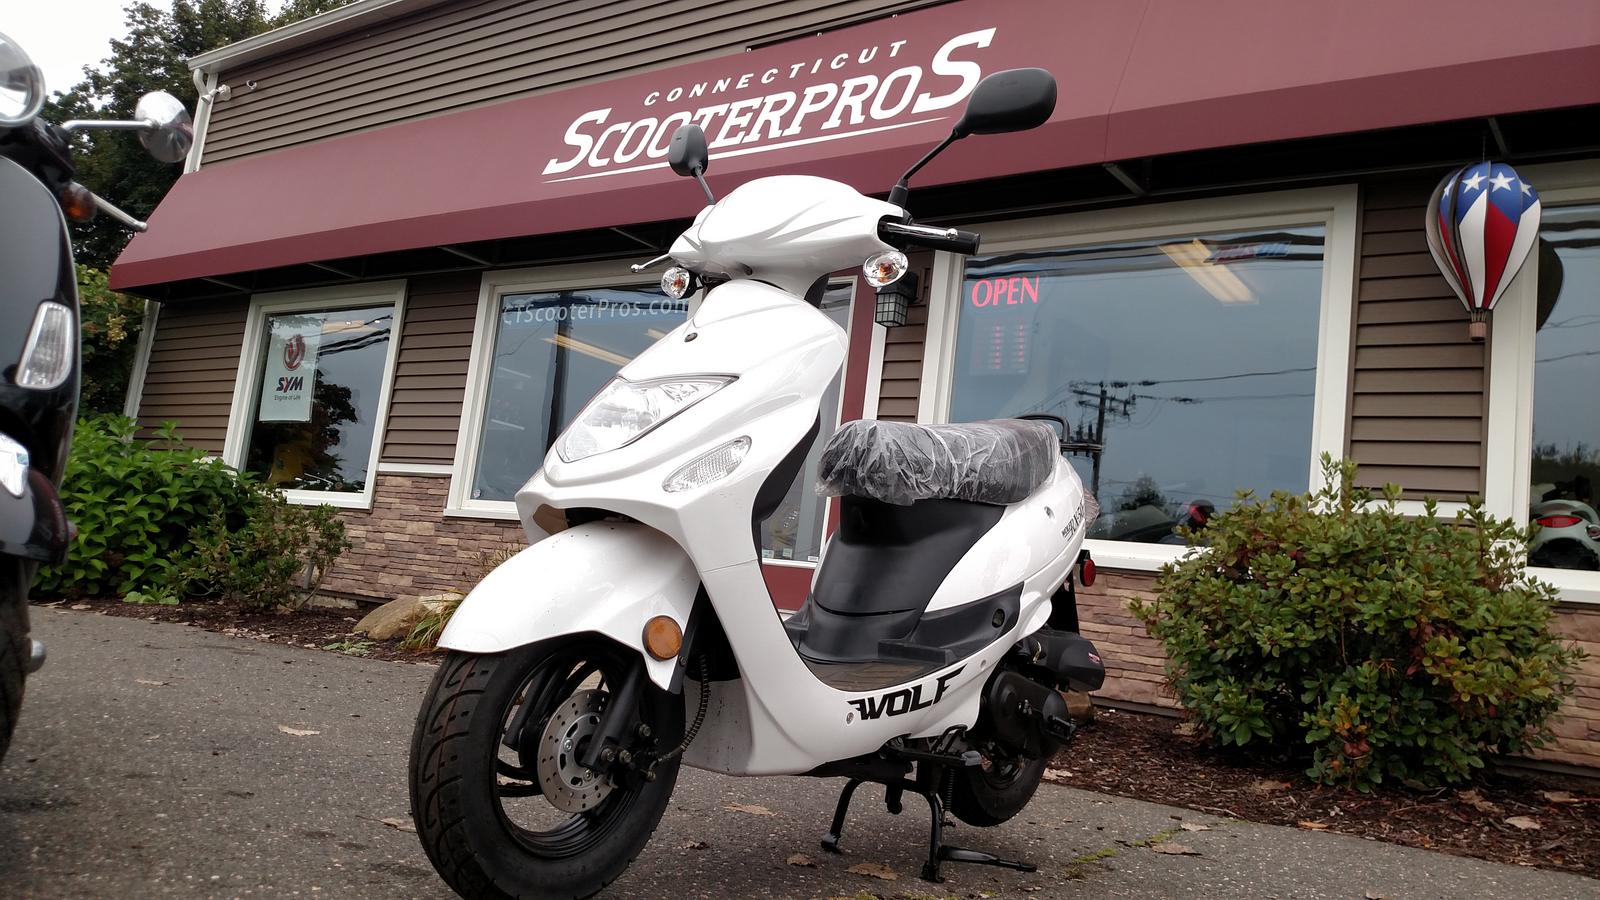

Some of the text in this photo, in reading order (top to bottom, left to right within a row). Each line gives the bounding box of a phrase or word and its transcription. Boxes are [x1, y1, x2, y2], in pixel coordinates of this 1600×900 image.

[643, 40, 907, 106] CONNECTICUT
[971, 275, 1039, 308] OPEN
[276, 376, 304, 393] SYM
[847, 663, 968, 721] WOLF
